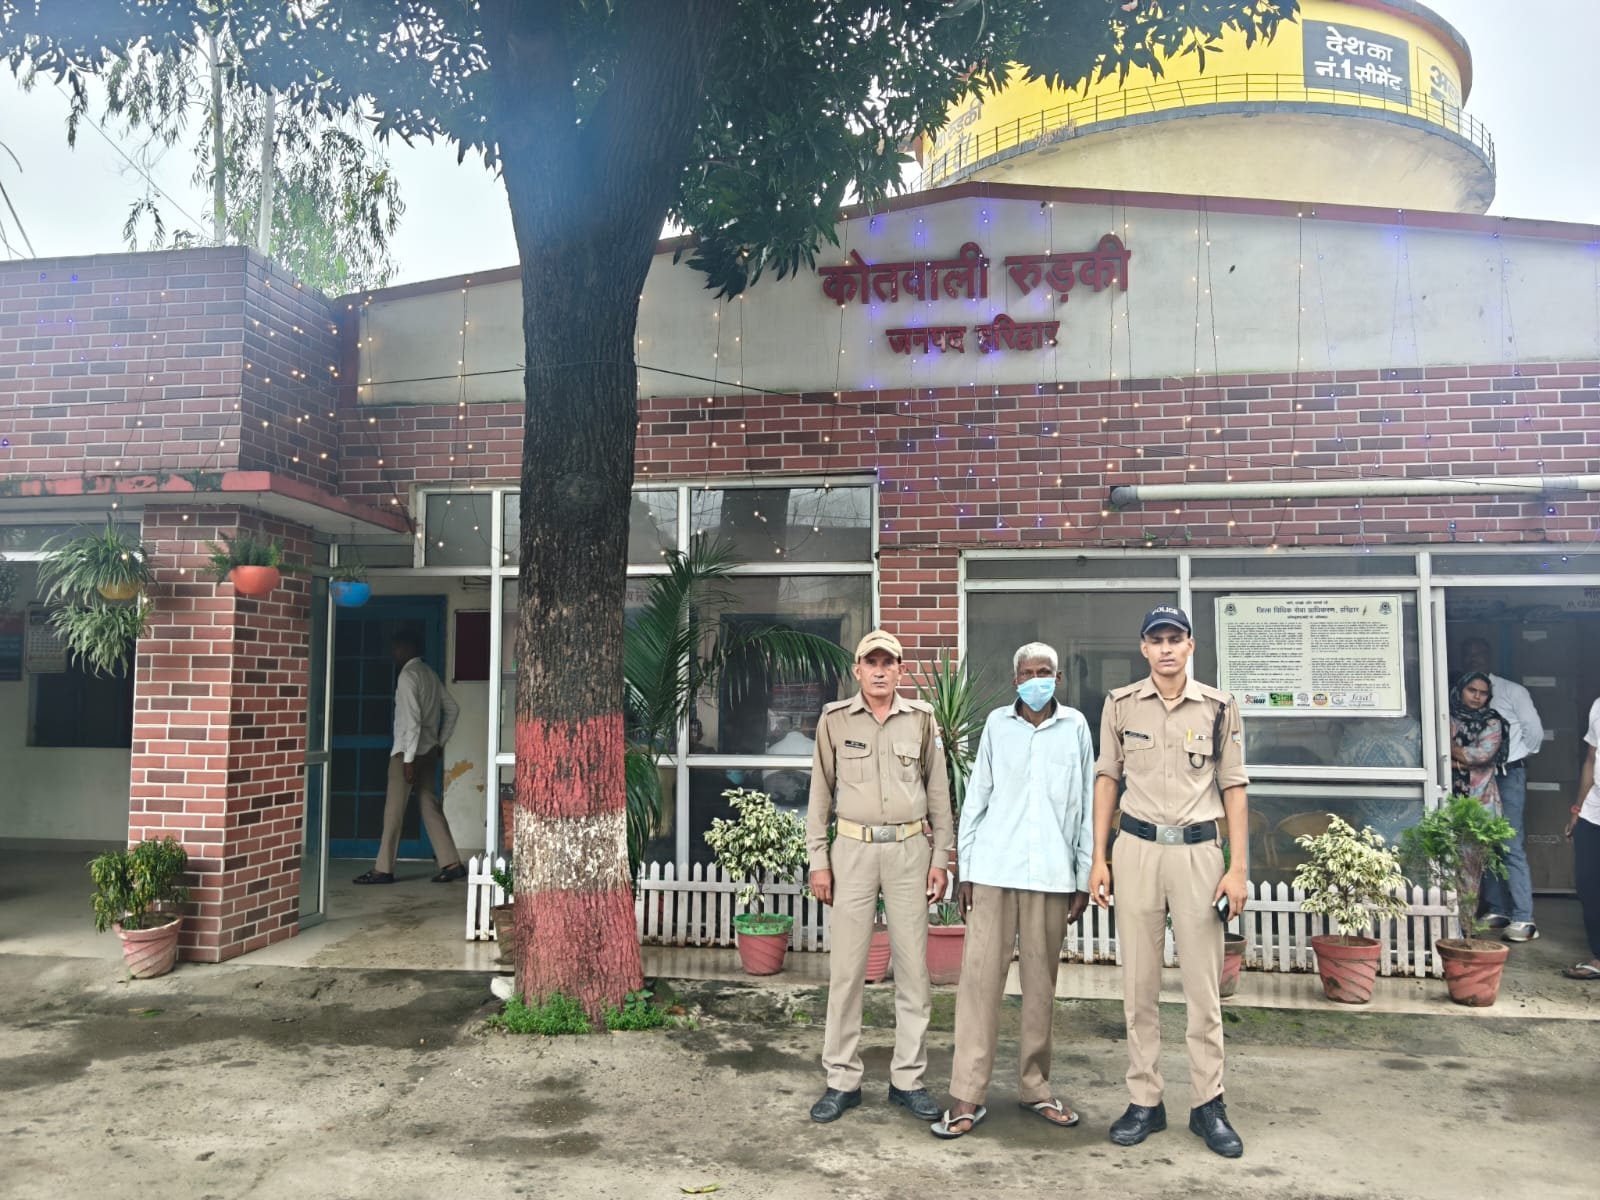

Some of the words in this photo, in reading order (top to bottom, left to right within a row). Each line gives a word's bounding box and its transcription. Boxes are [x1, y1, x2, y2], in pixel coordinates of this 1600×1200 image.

[1325, 26, 1365, 56] देश
[1367, 41, 1394, 63] का
[1314, 56, 1351, 80] नं.1
[1354, 62, 1403, 91] सीमेंट
[818, 241, 990, 305] कोतवाली
[1004, 233, 1132, 303] रुड़की
[885, 325, 967, 355] जनपद
[974, 313, 1060, 354] हरिद्वार
